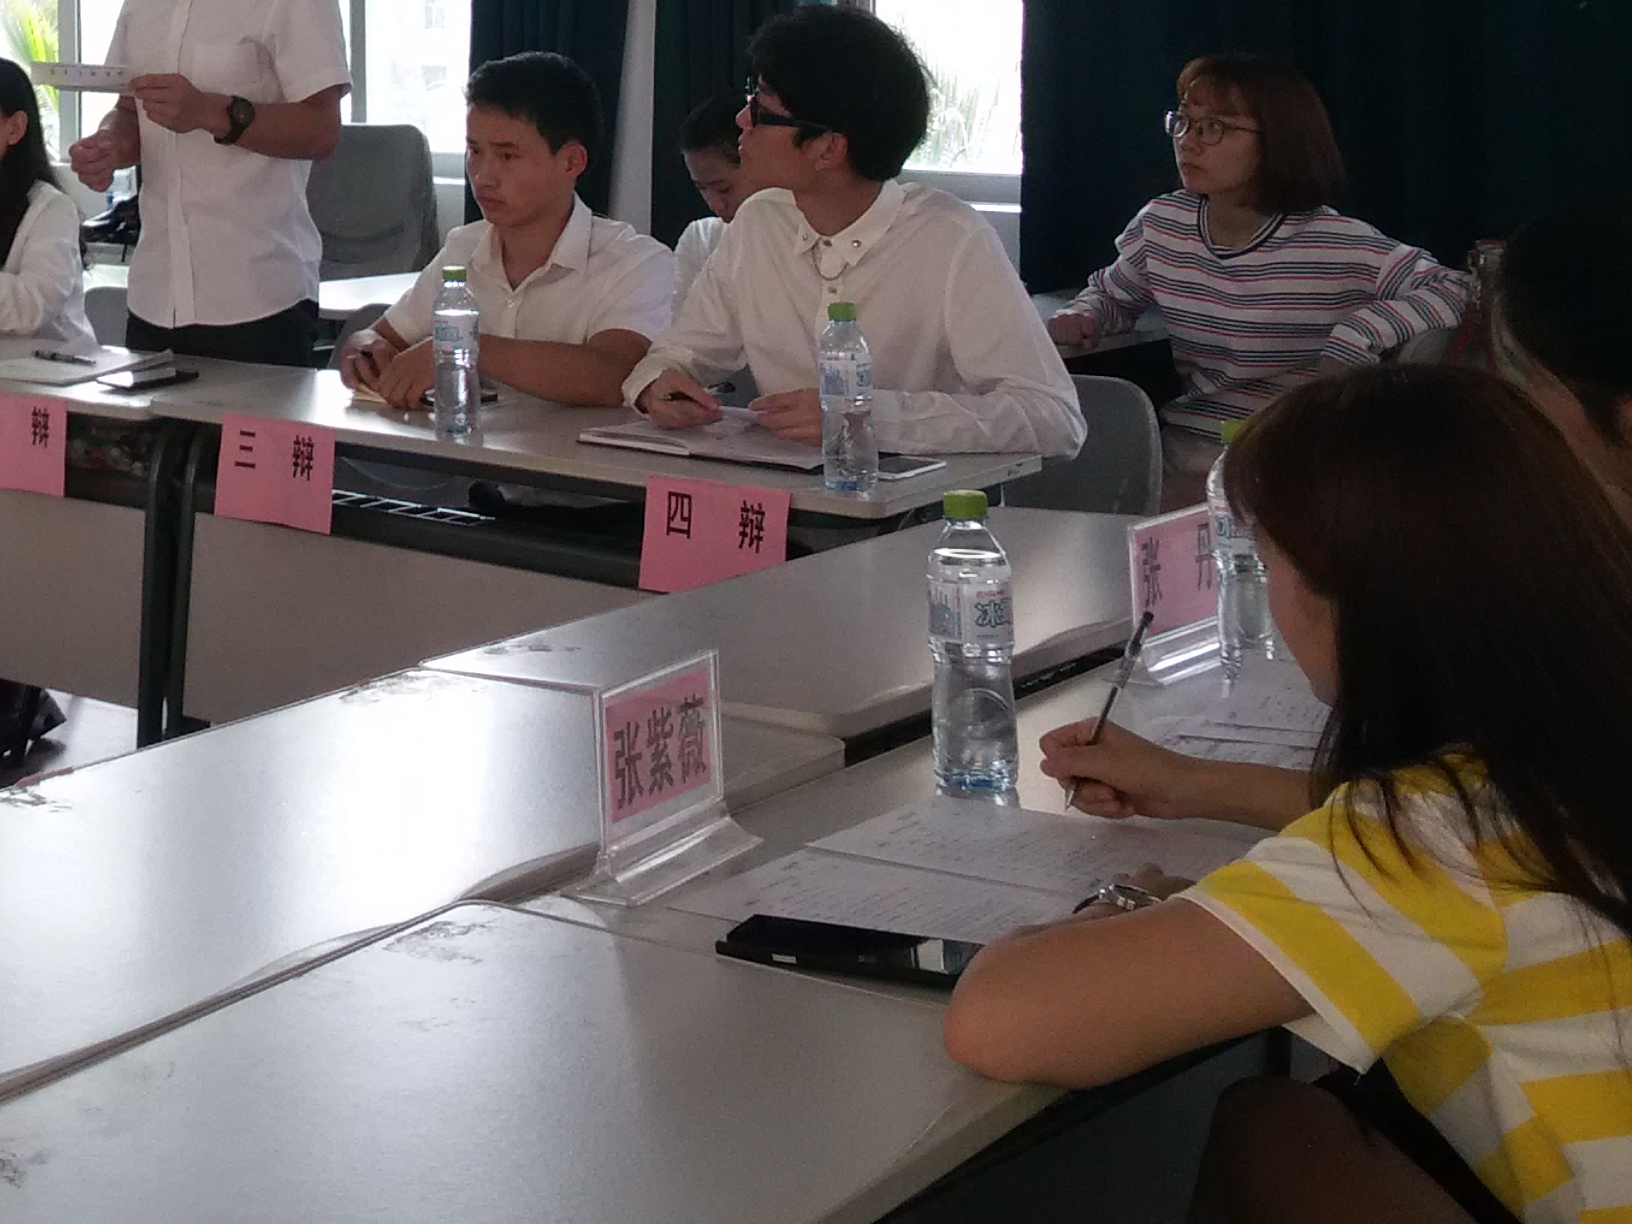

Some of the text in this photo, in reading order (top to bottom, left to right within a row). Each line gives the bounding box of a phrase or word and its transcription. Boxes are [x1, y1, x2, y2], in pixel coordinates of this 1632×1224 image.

[234, 429, 315, 481] 三辩
[665, 490, 767, 555] 四辩
[613, 693, 706, 811] 张紫薇
